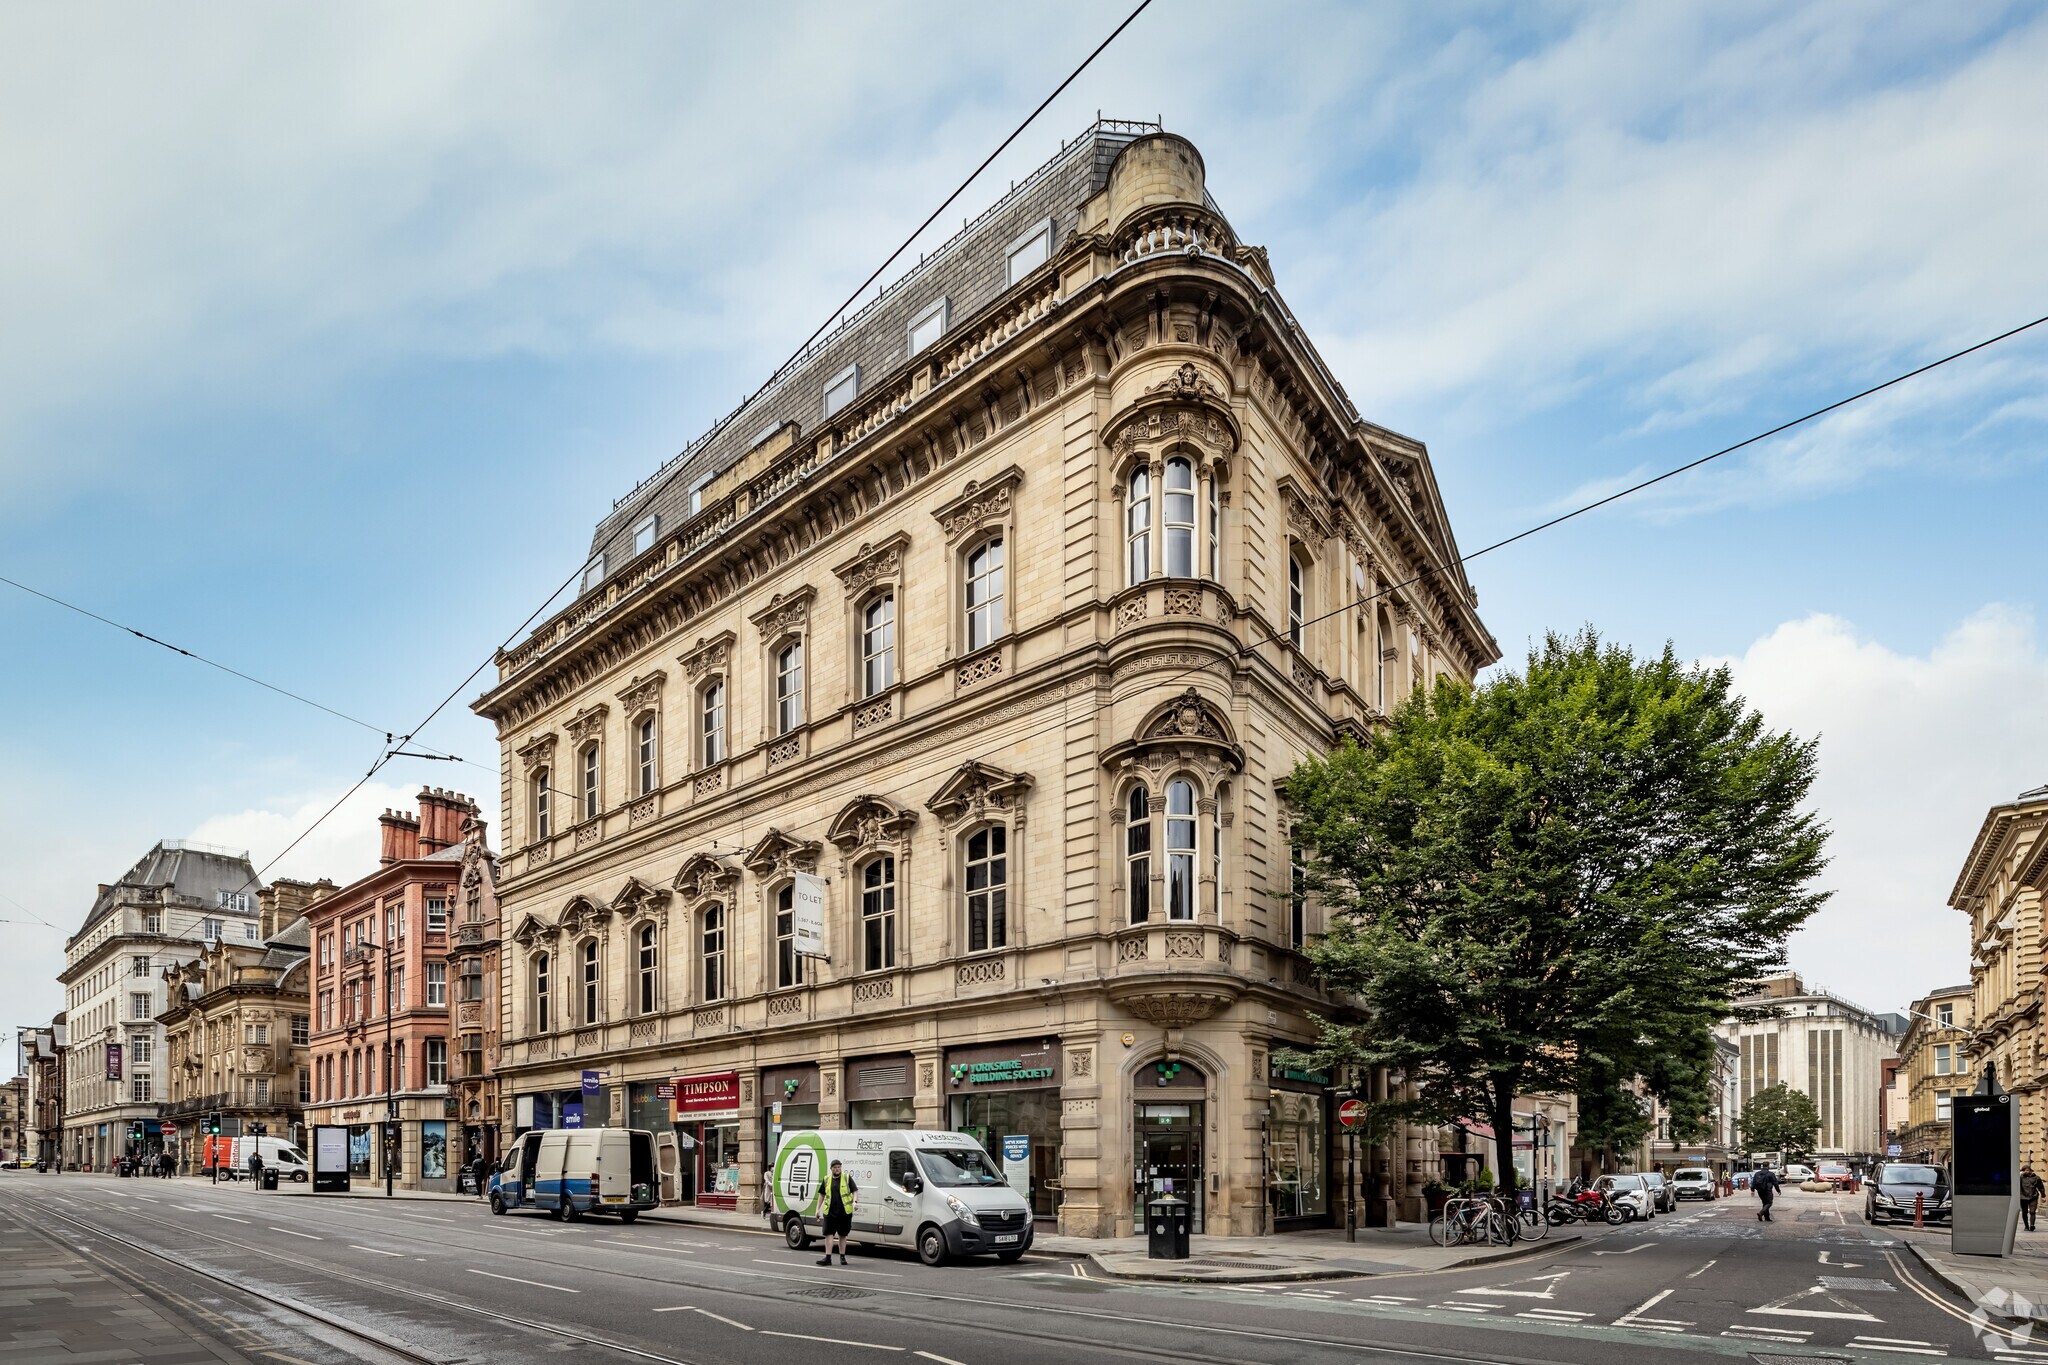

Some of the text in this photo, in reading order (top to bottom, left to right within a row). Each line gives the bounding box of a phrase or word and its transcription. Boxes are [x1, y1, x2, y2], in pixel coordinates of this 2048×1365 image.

[798, 892, 822, 904] TO LET
[970, 1060, 1022, 1073] YORKSHIRE
[970, 1067, 1053, 1083] BUILDING SOCIETY
[684, 1080, 729, 1095] TIMPSON
[565, 1113, 580, 1123] smile
[857, 1138, 883, 1149] Restore
[893, 1199, 912, 1209] Restore
